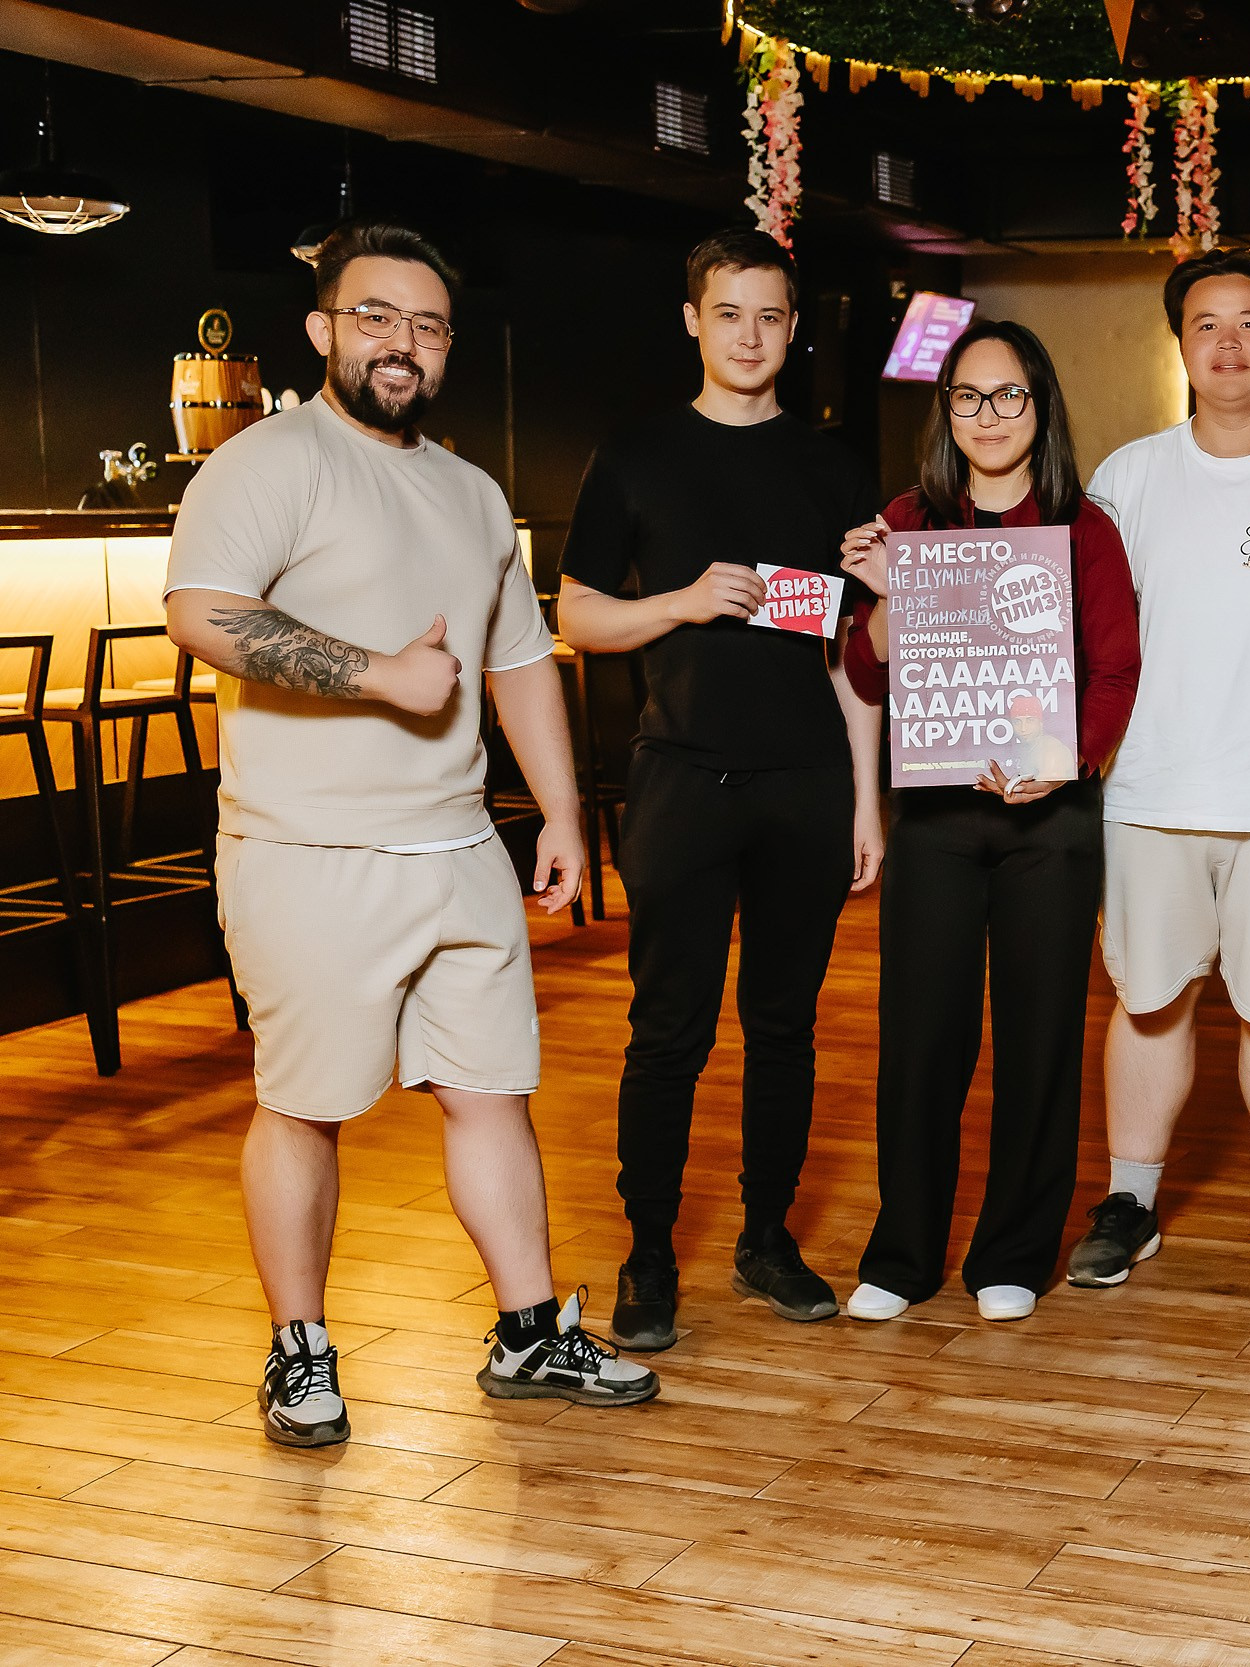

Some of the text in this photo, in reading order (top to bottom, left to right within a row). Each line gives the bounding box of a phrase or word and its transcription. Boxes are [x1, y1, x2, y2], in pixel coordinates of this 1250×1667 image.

[897, 540, 1013, 565] 2 МЕСТО
[888, 566, 987, 592] НЕ ДУМАЕМ
[890, 594, 939, 615] ДАЖЕ
[899, 631, 972, 645] КОМАНДЕ,
[899, 643, 1058, 659] КОТОРАЯ БЫЛА ПОЧТИ
[899, 657, 1075, 689] САААААА
[901, 717, 1021, 748] КРУТО
